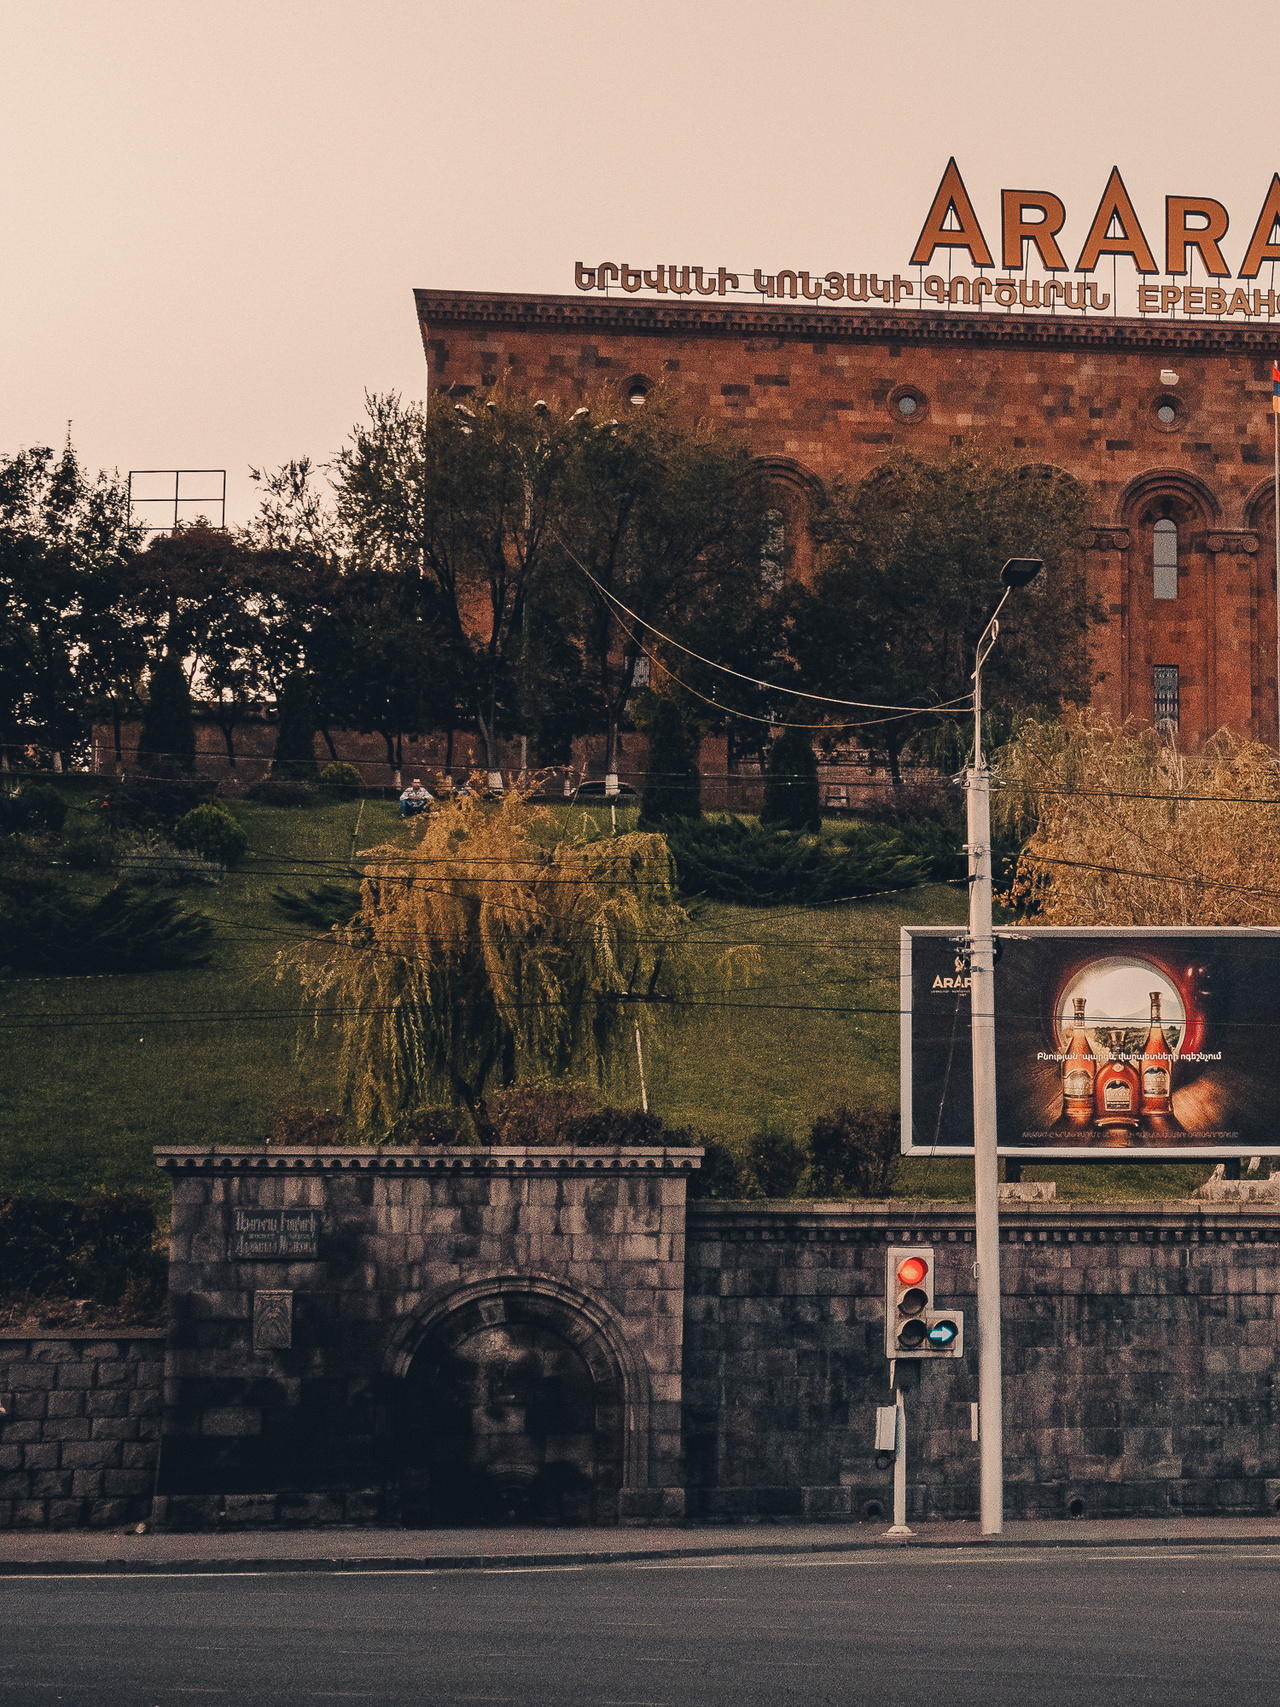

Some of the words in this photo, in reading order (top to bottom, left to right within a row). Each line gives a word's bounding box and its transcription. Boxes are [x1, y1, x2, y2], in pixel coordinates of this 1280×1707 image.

[574, 261, 740, 296] ԵՐԵՎԱՆԻ
[753, 268, 914, 303] ԿՈՆՅԱԿԻ
[924, 275, 1110, 310] ԳՈՐԾԱՐԱՆ
